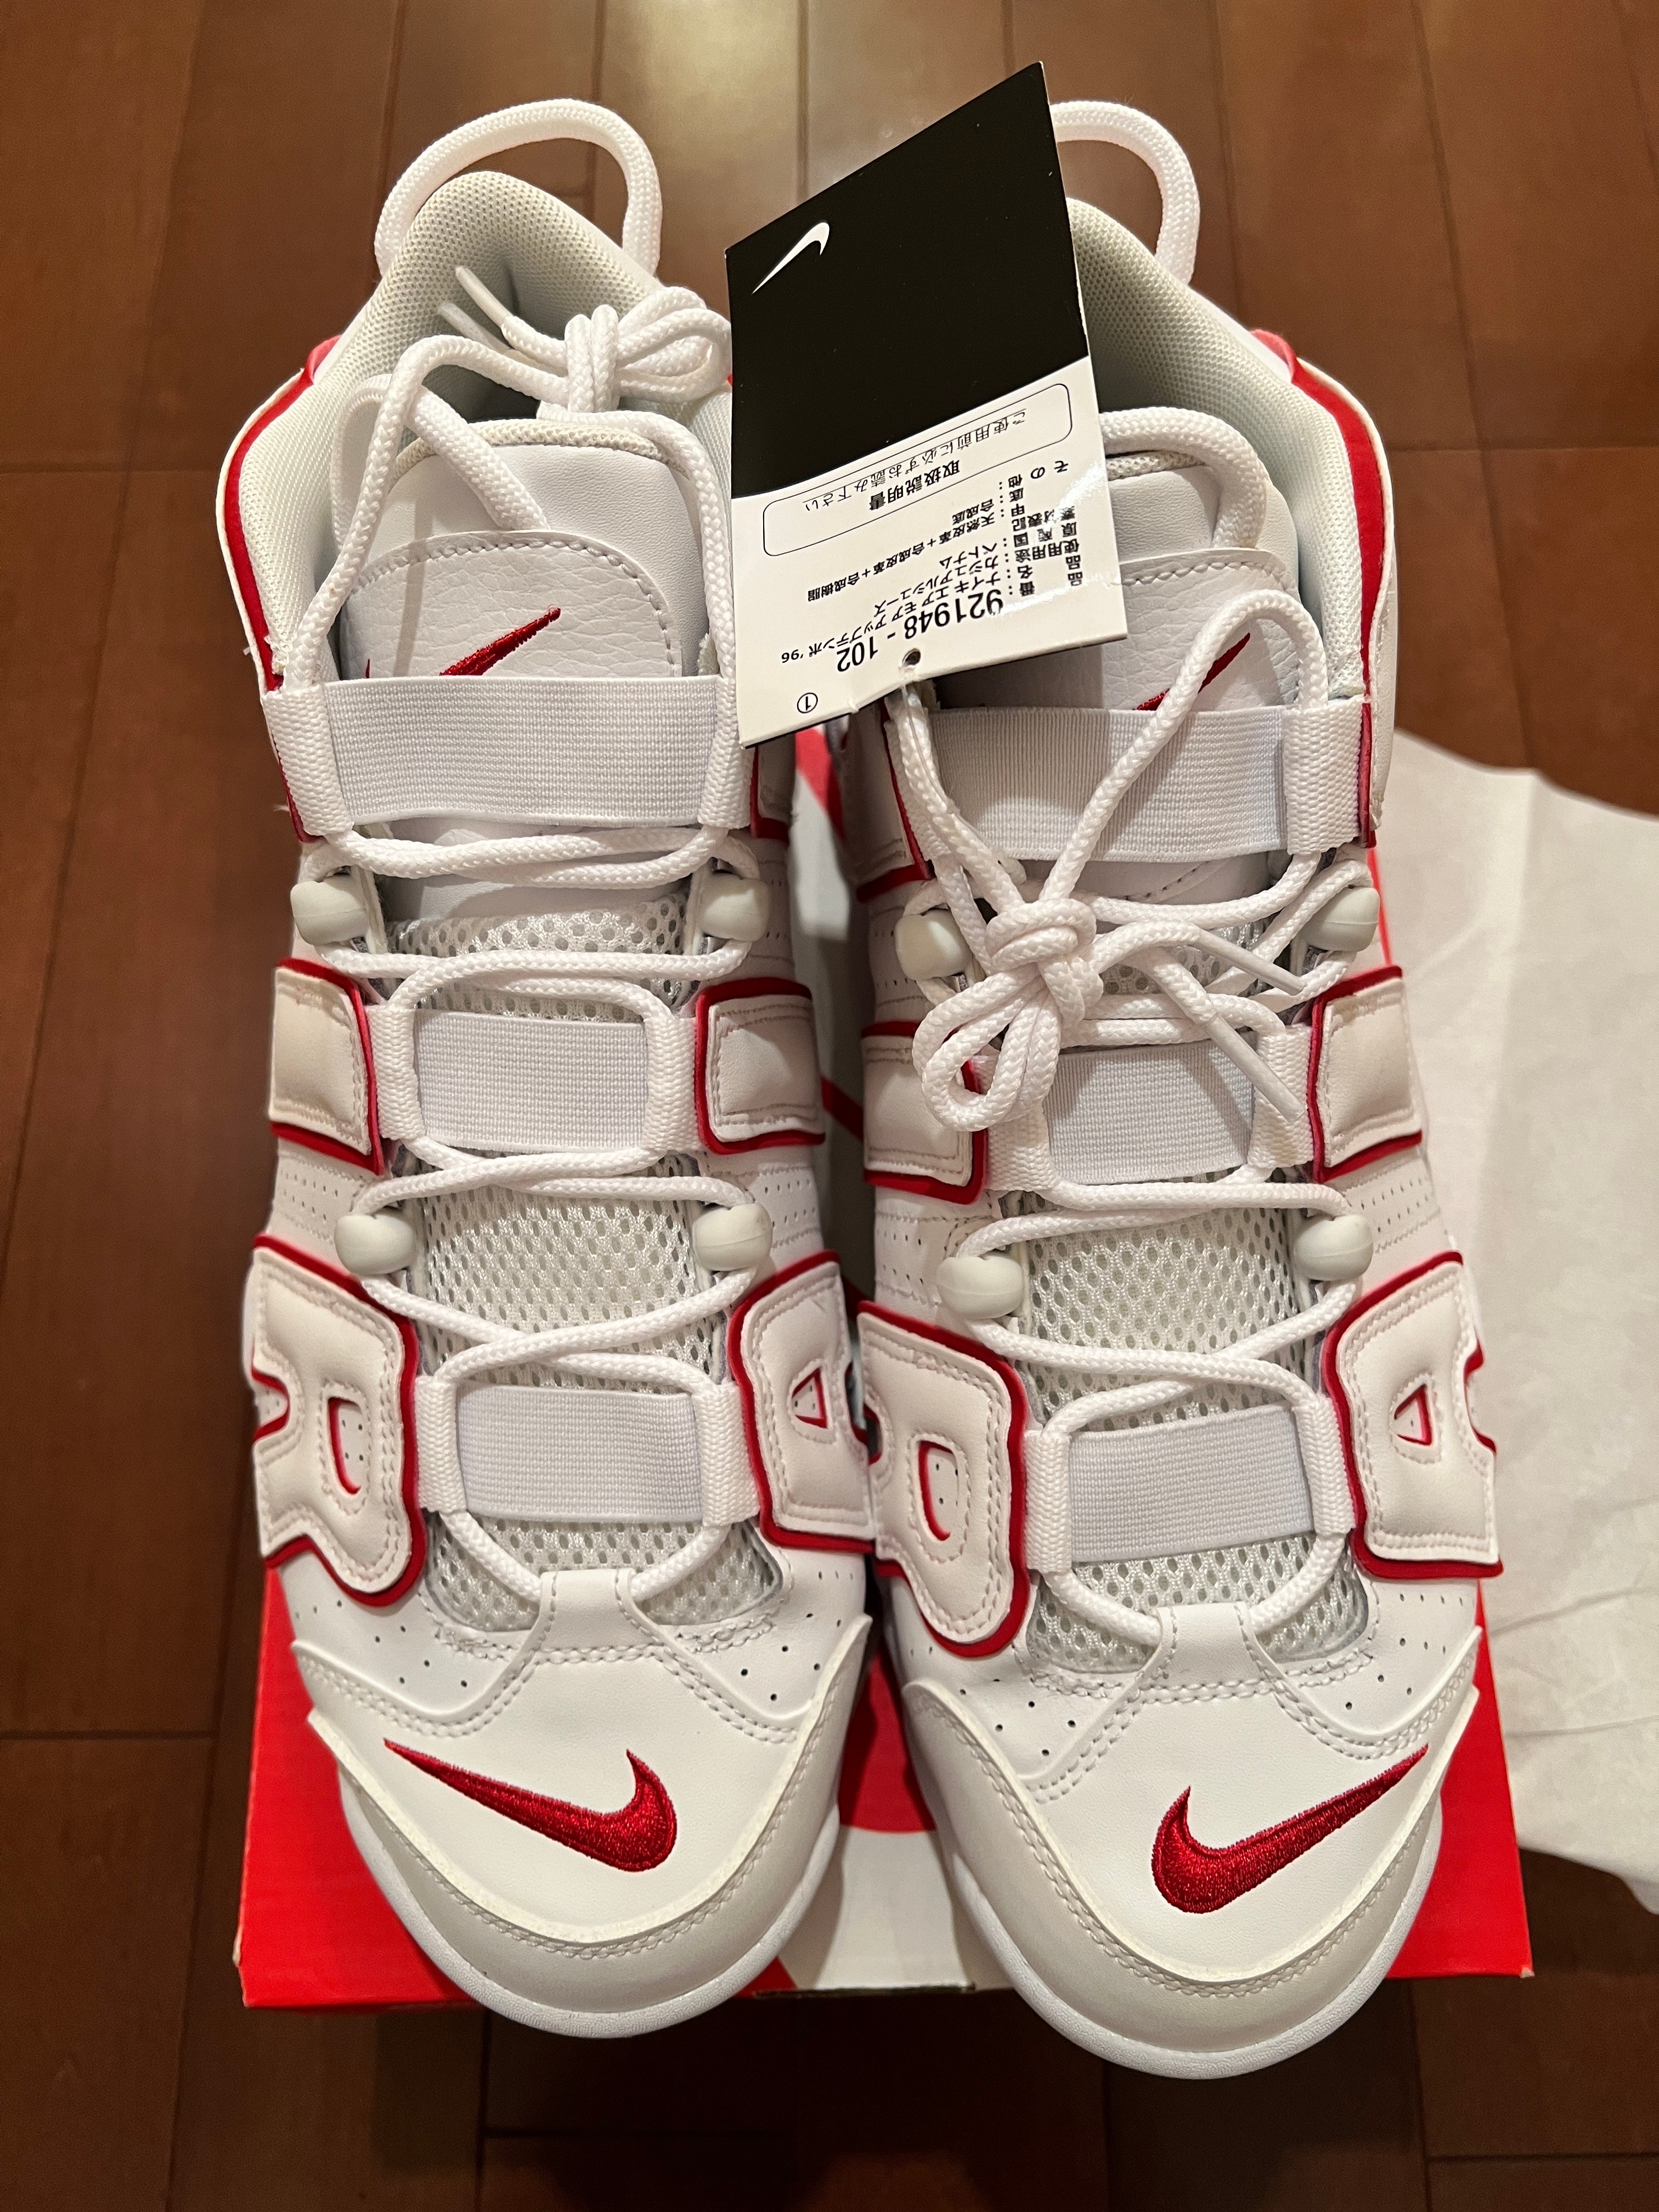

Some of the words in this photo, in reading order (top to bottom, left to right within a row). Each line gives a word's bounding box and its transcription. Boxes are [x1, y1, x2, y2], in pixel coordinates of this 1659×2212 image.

[805, 411, 1026, 512] ご使用前に必ずお読み下さい
[869, 460, 961, 511] 取扱説明書
[904, 589, 1004, 640] 921948
[837, 636, 878, 672] 102
